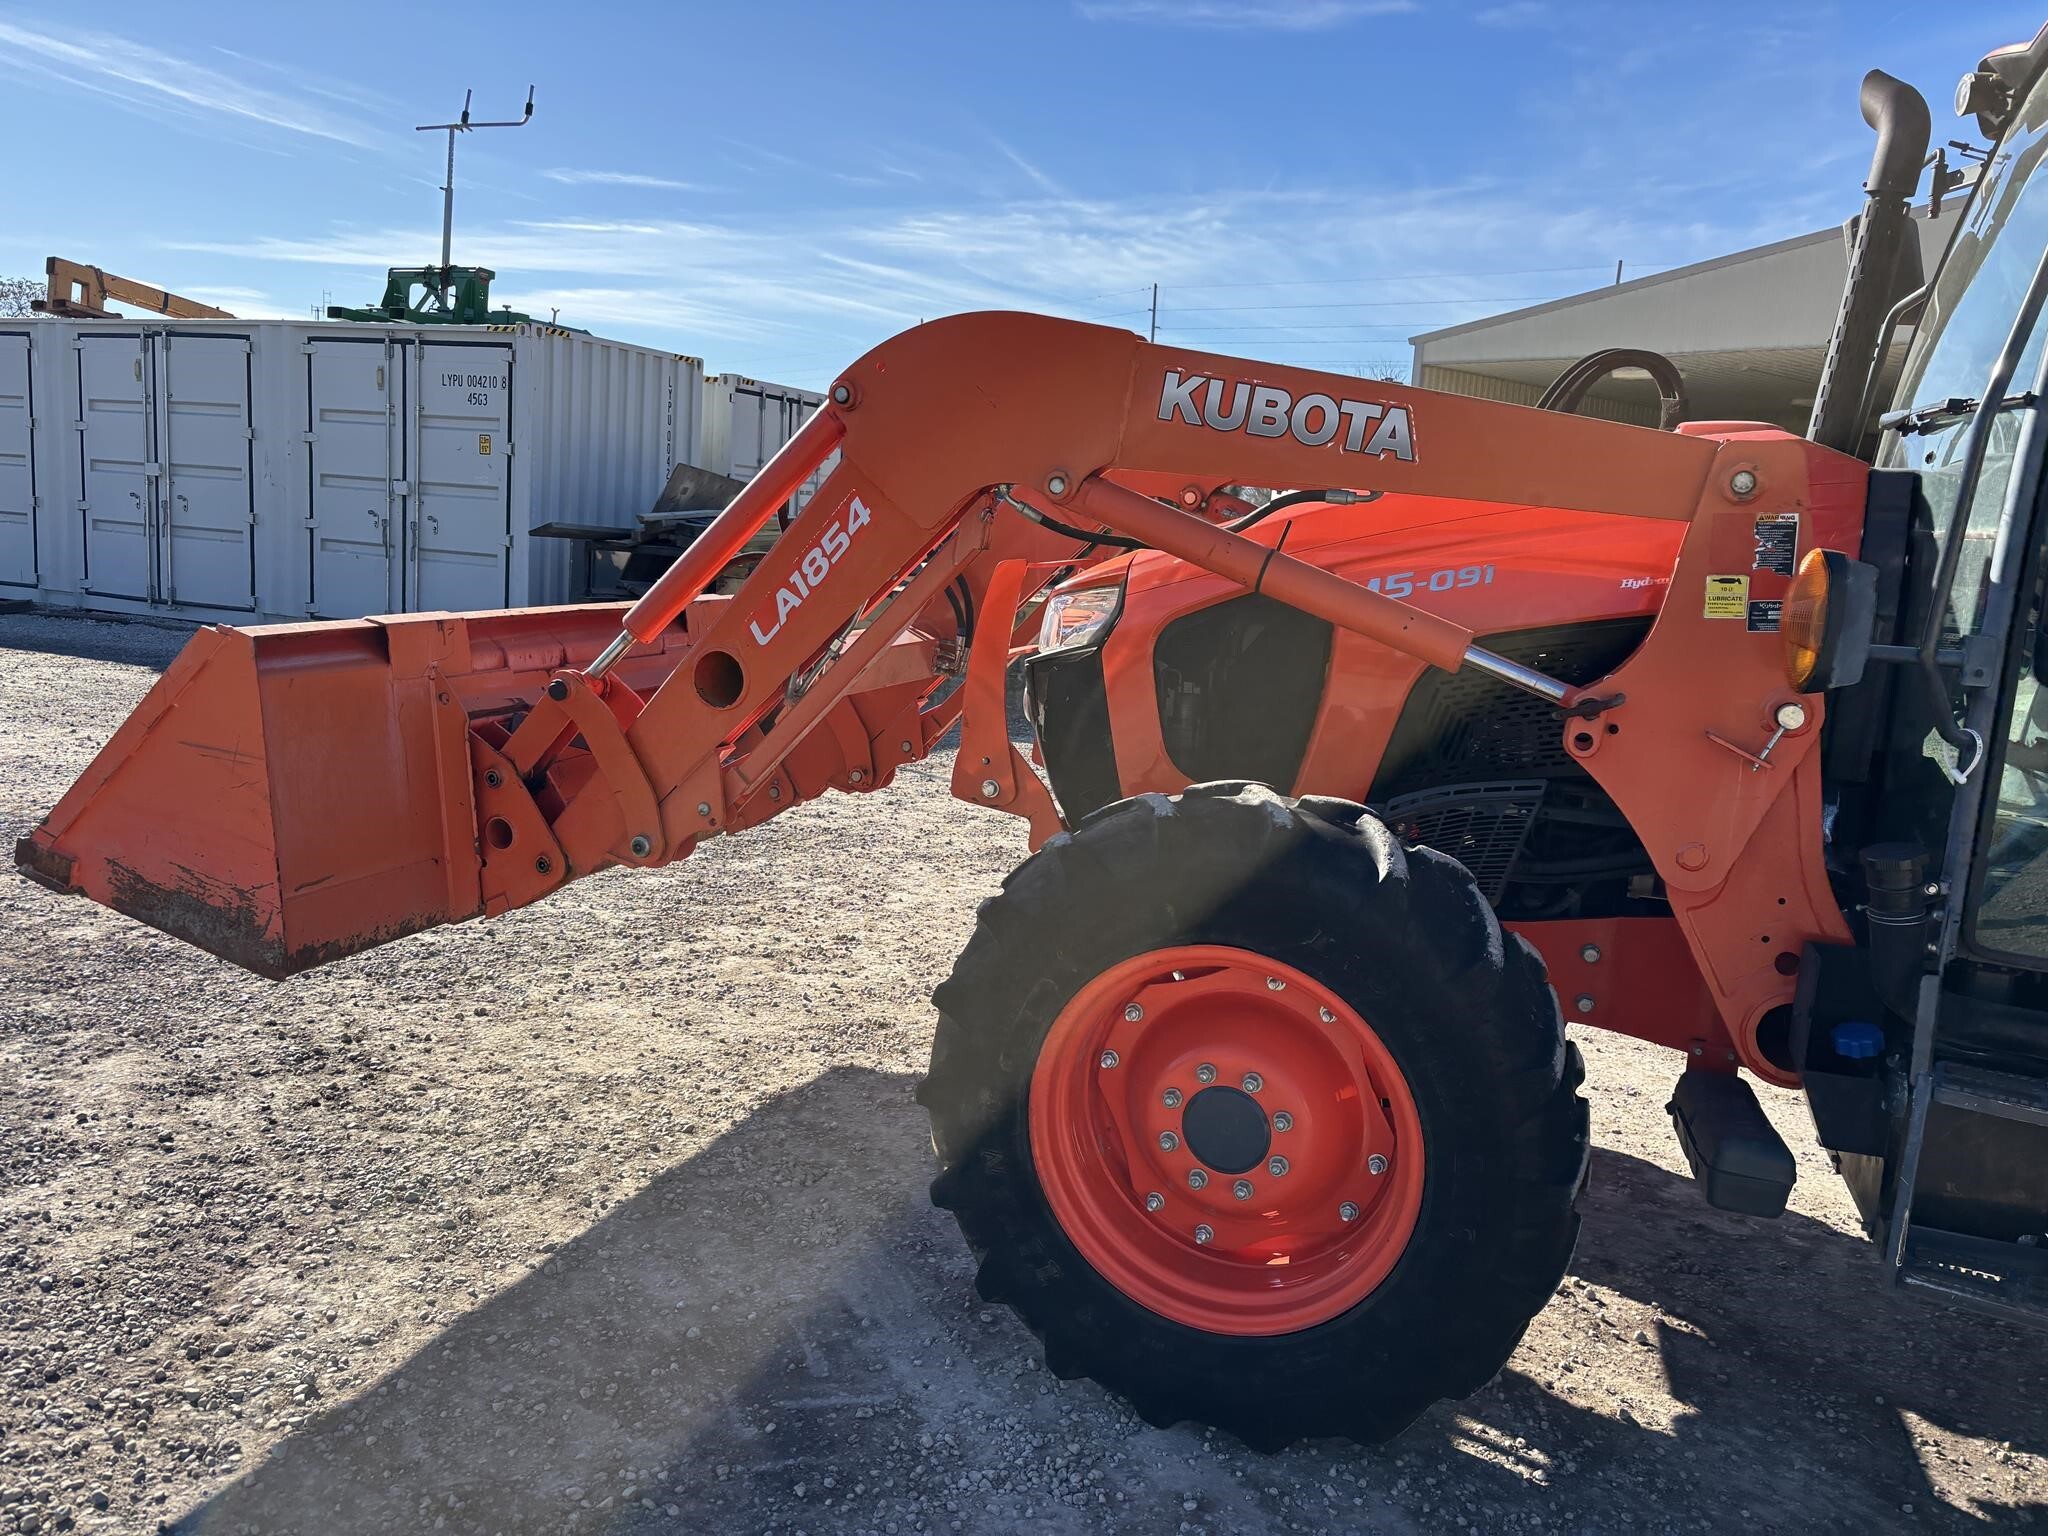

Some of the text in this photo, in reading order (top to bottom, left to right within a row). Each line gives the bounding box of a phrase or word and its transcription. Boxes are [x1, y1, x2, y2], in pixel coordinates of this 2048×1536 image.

[441, 373, 507, 390] LYPU 004210 8
[467, 392, 488, 406] 45G3
[1157, 370, 1414, 461] KUBOTA
[749, 496, 871, 646] LA1854
